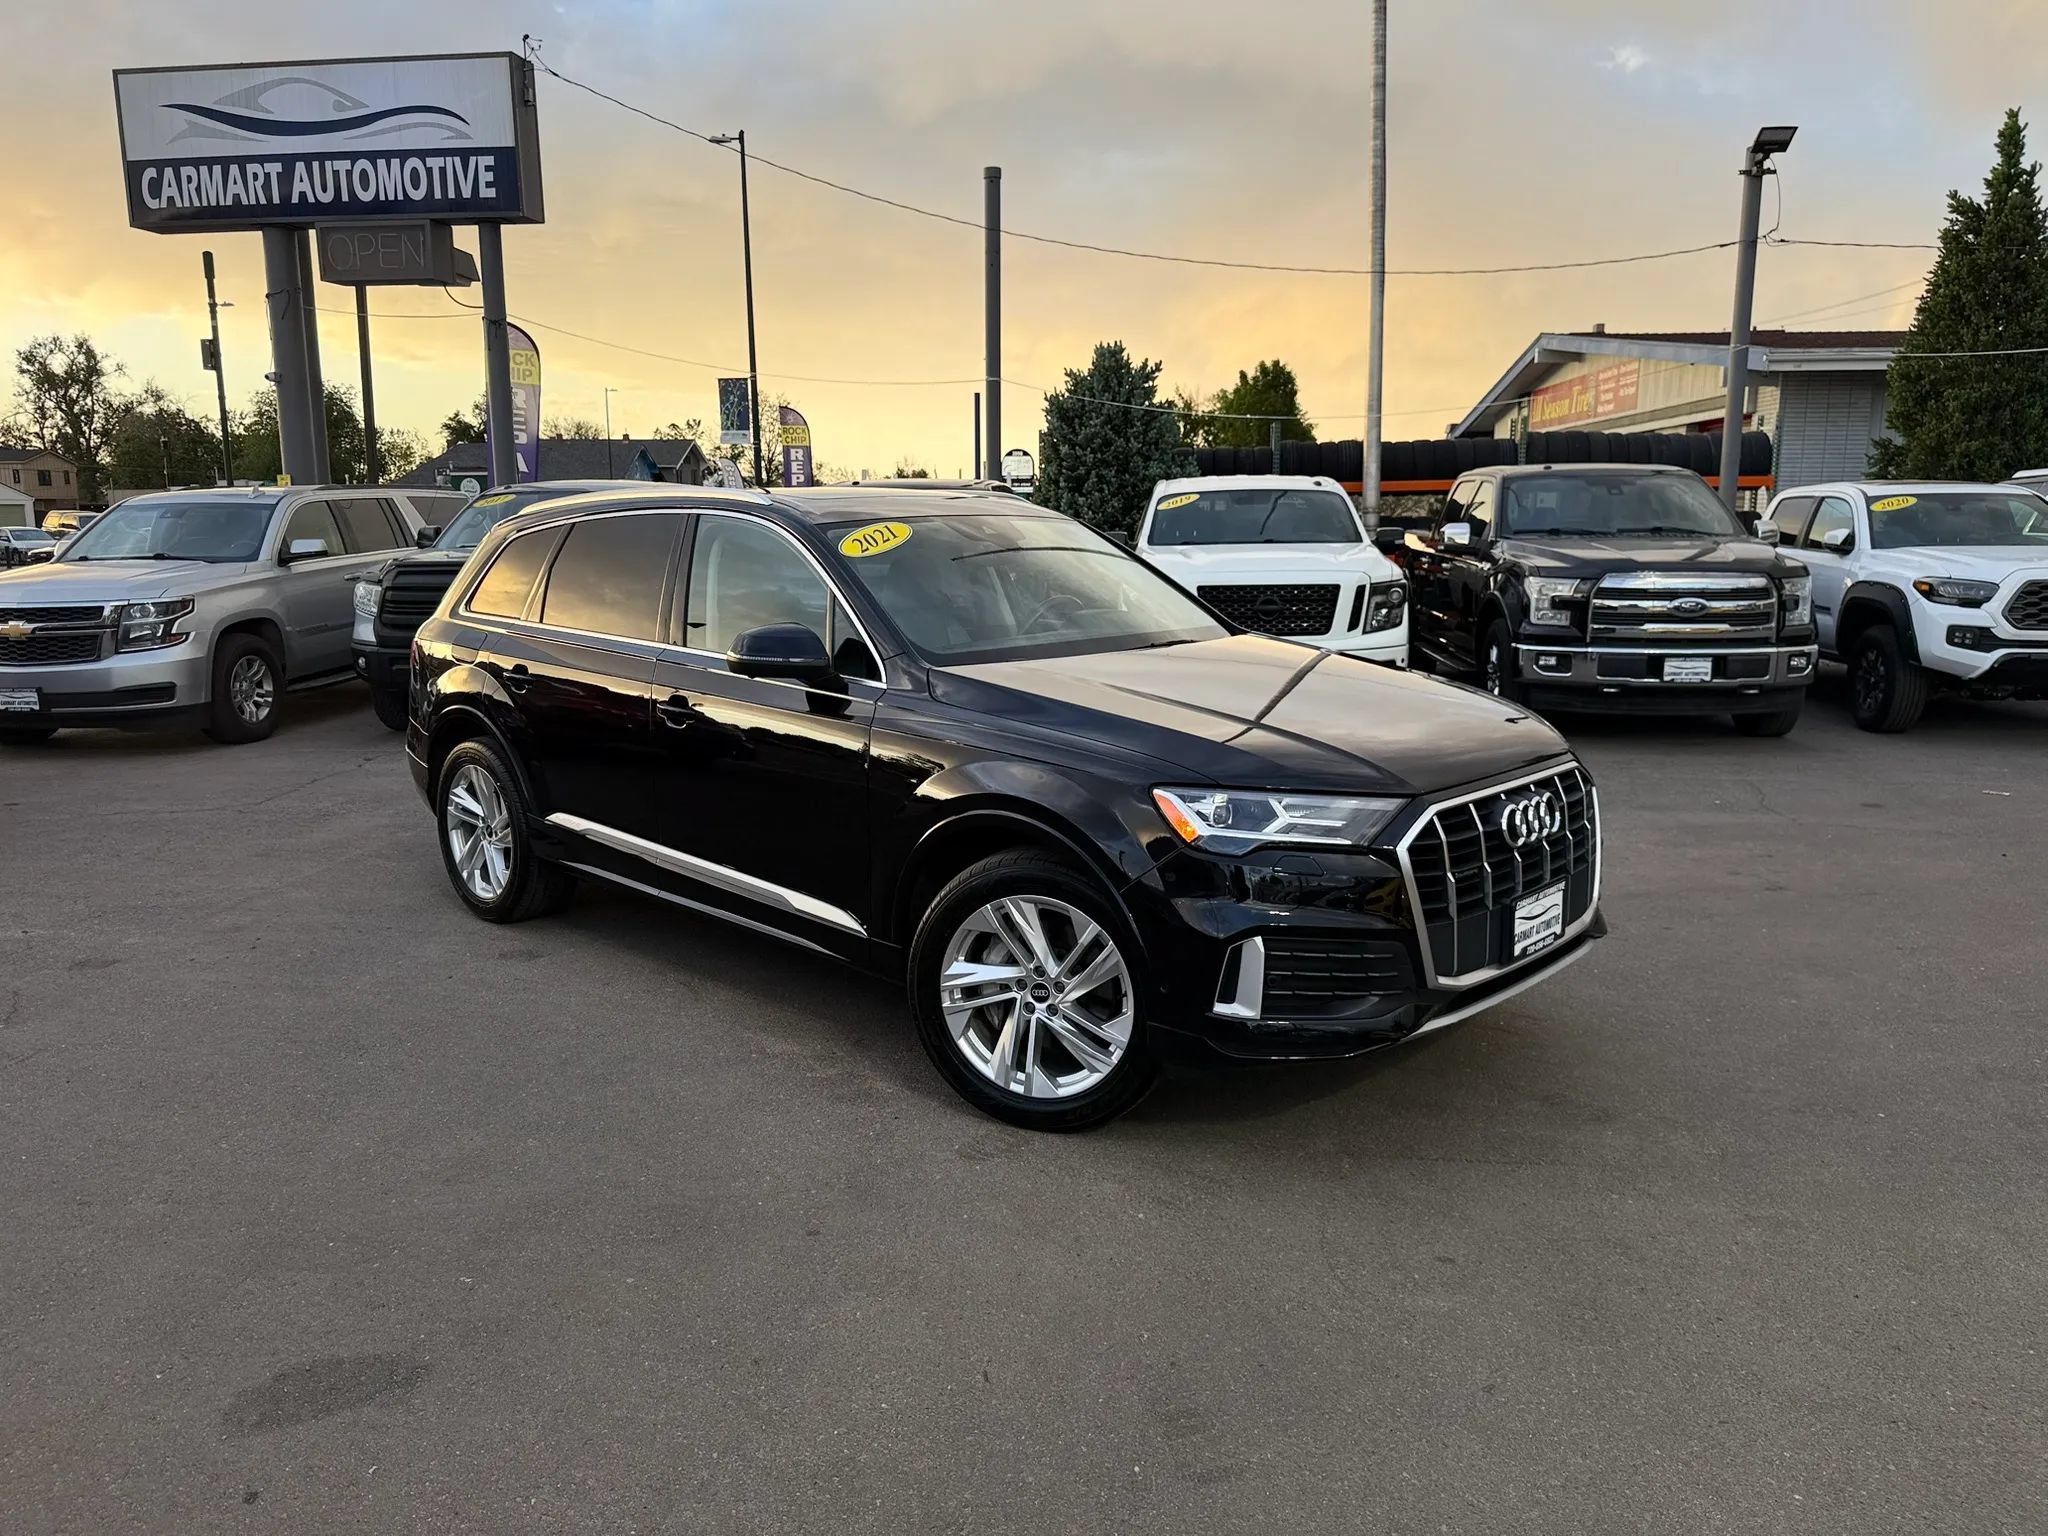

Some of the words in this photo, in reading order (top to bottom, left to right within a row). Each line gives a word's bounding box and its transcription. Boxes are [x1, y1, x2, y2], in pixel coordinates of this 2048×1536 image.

[141, 162, 283, 210] CARMART
[291, 155, 497, 205] AUTOMOTIVE
[327, 231, 424, 271] OPEN
[782, 426, 807, 435] ROCK
[784, 435, 807, 444] CHIP
[1166, 495, 1191, 508] 2019
[1881, 496, 1909, 510] 2020
[851, 524, 898, 554] 2021
[1514, 924, 1536, 944] CARMART
